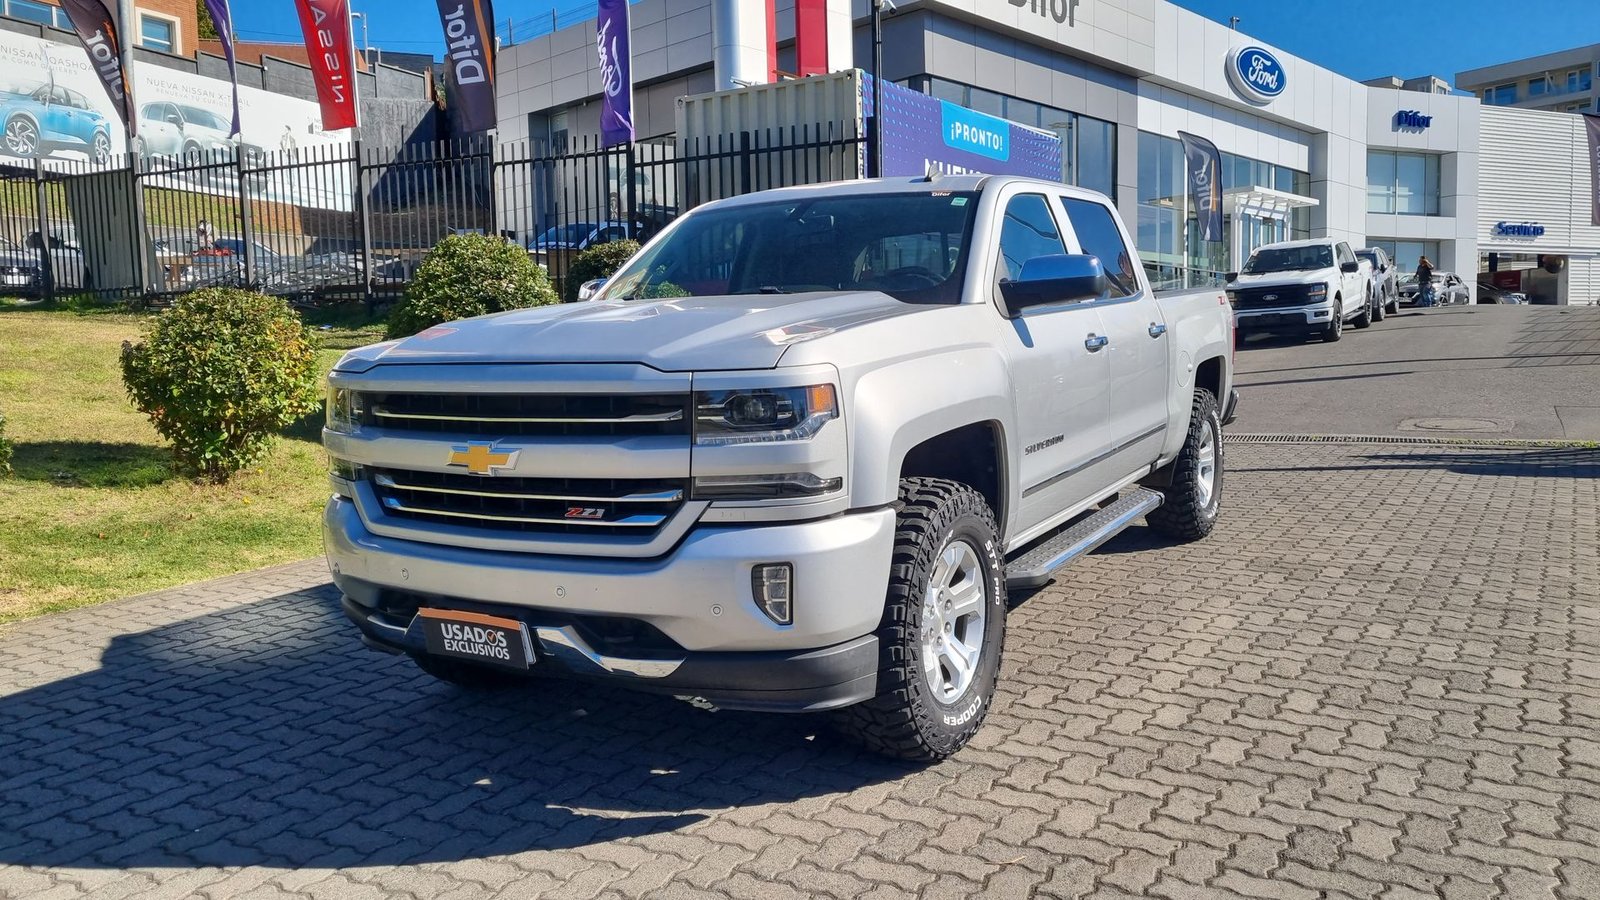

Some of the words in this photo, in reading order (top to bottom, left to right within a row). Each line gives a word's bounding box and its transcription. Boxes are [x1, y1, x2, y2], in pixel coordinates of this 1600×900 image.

[0, 45, 42, 61] NISSAN
[49, 56, 95, 72] QASHQA
[1249, 54, 1278, 89] Ford
[146, 78, 178, 90] NUEVA
[182, 85, 214, 98] NISSAN
[218, 94, 250, 107] X-TAIL
[951, 121, 1003, 151] ¡PRONTO!
[565, 507, 605, 518] Z71
[984, 540, 999, 571] STT
[440, 623, 507, 647] USADOS
[444, 639, 510, 660] EXCLUSIVOS
[943, 696, 982, 726] COOPER
